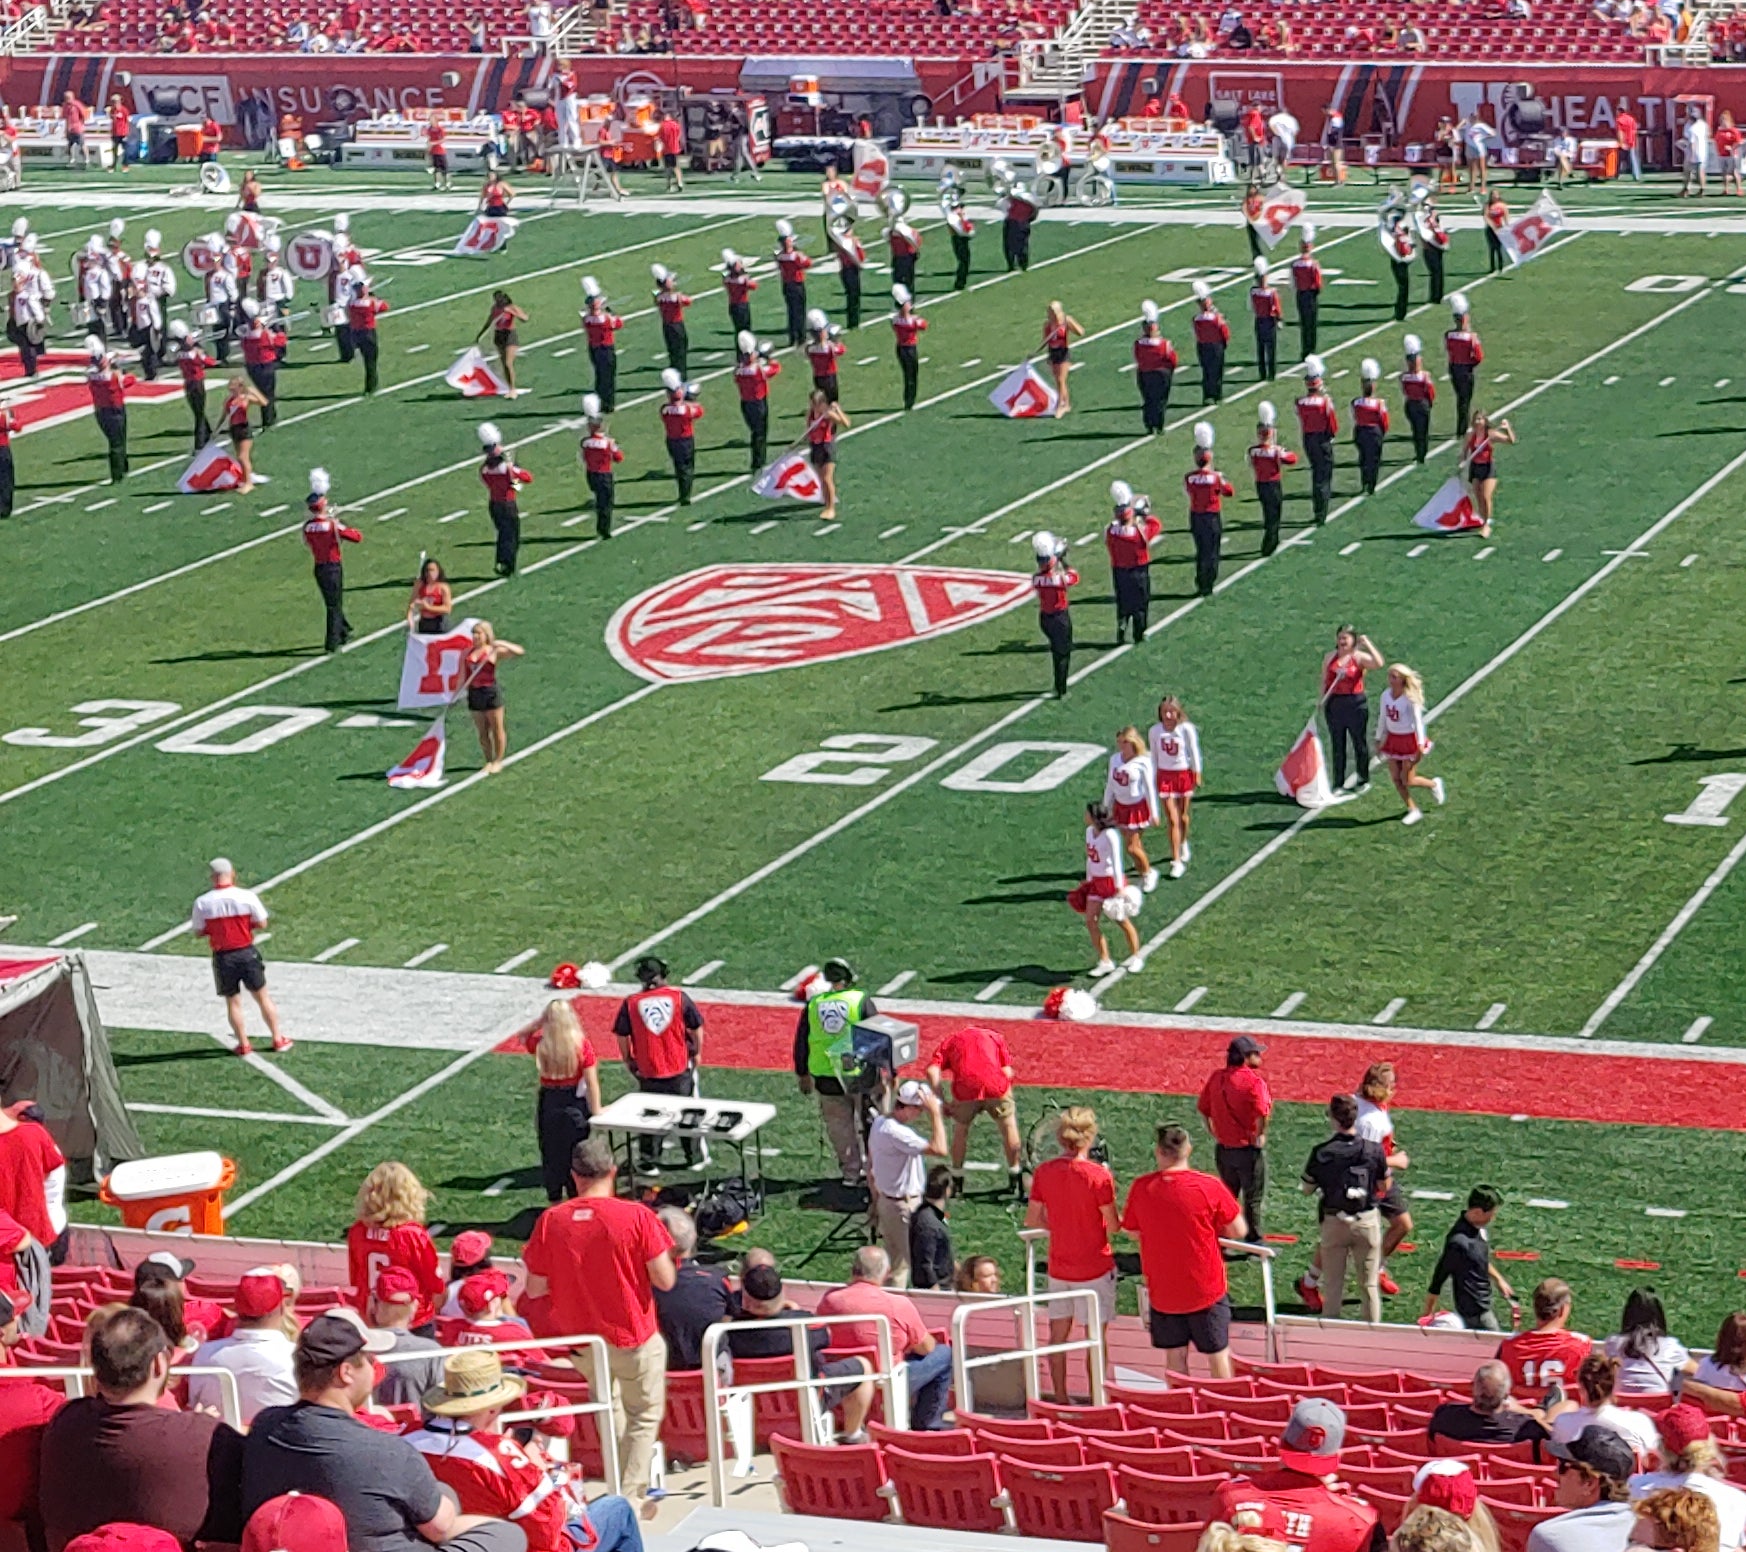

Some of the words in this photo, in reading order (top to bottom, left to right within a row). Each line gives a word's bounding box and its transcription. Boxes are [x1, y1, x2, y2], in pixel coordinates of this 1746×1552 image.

[1246, 89, 1276, 101] LAKE
[0, 698, 331, 754] 30
[758, 733, 1108, 792] 20
[457, 1331, 493, 1346] UTES
[1522, 1359, 1566, 1397] 16
